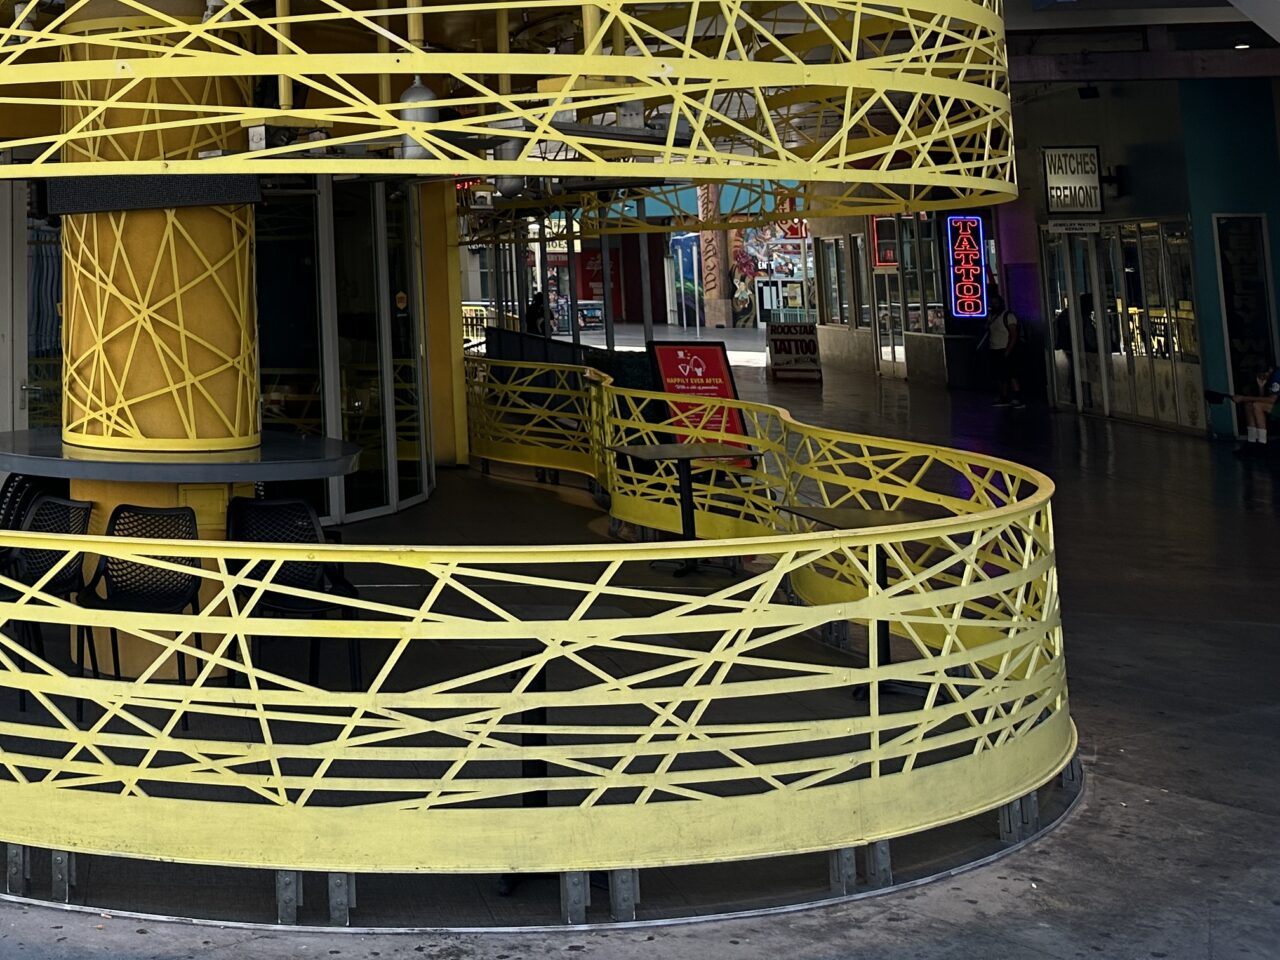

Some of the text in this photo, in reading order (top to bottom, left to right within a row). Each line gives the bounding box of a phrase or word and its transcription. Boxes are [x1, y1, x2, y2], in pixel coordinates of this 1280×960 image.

[1047, 153, 1097, 175] WATCHES
[1049, 185, 1099, 208] FREMONT
[952, 219, 983, 315] TATTOO
[771, 325, 815, 335] ROCKSTAR
[771, 339, 817, 355] TATTOO
